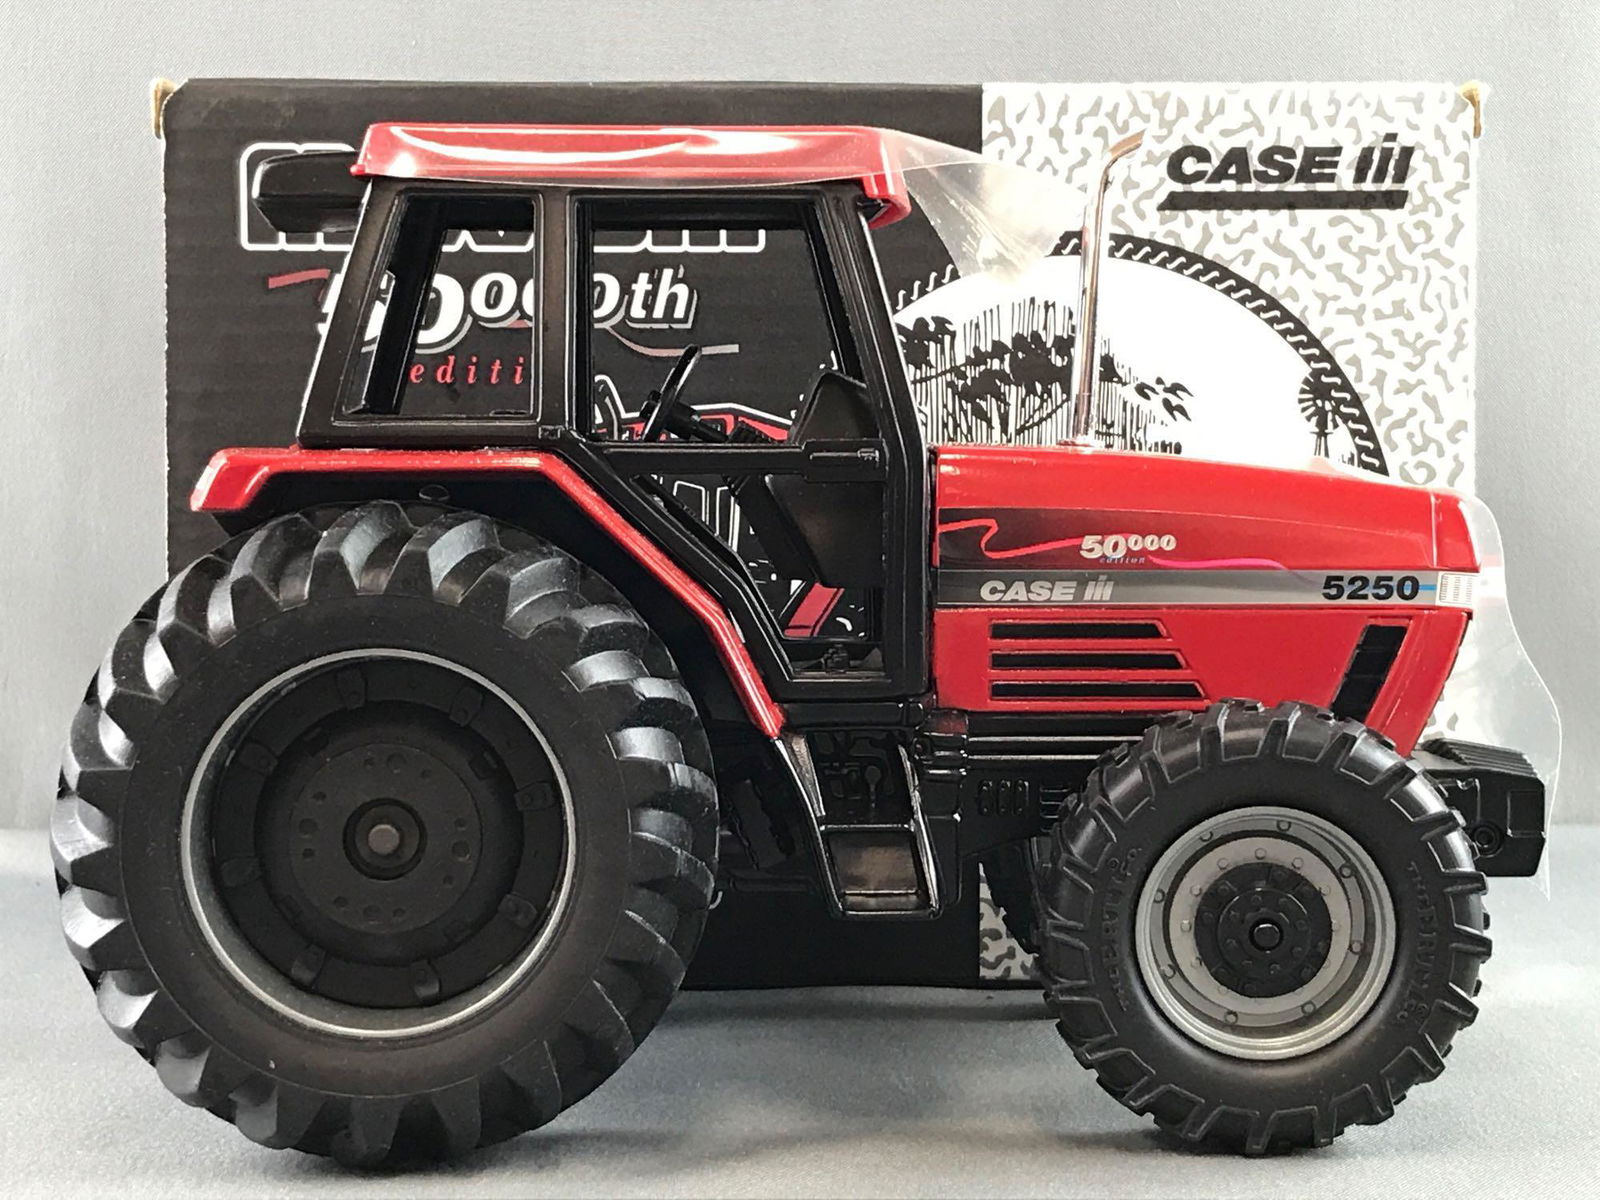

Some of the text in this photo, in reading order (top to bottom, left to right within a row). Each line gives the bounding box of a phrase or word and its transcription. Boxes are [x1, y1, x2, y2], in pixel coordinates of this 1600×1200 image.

[1166, 144, 1343, 184] CASE
[409, 354, 524, 384] editi
[1080, 534, 1177, 559] 50000
[980, 580, 1077, 601] CASE
[1321, 575, 1420, 601] 5250
